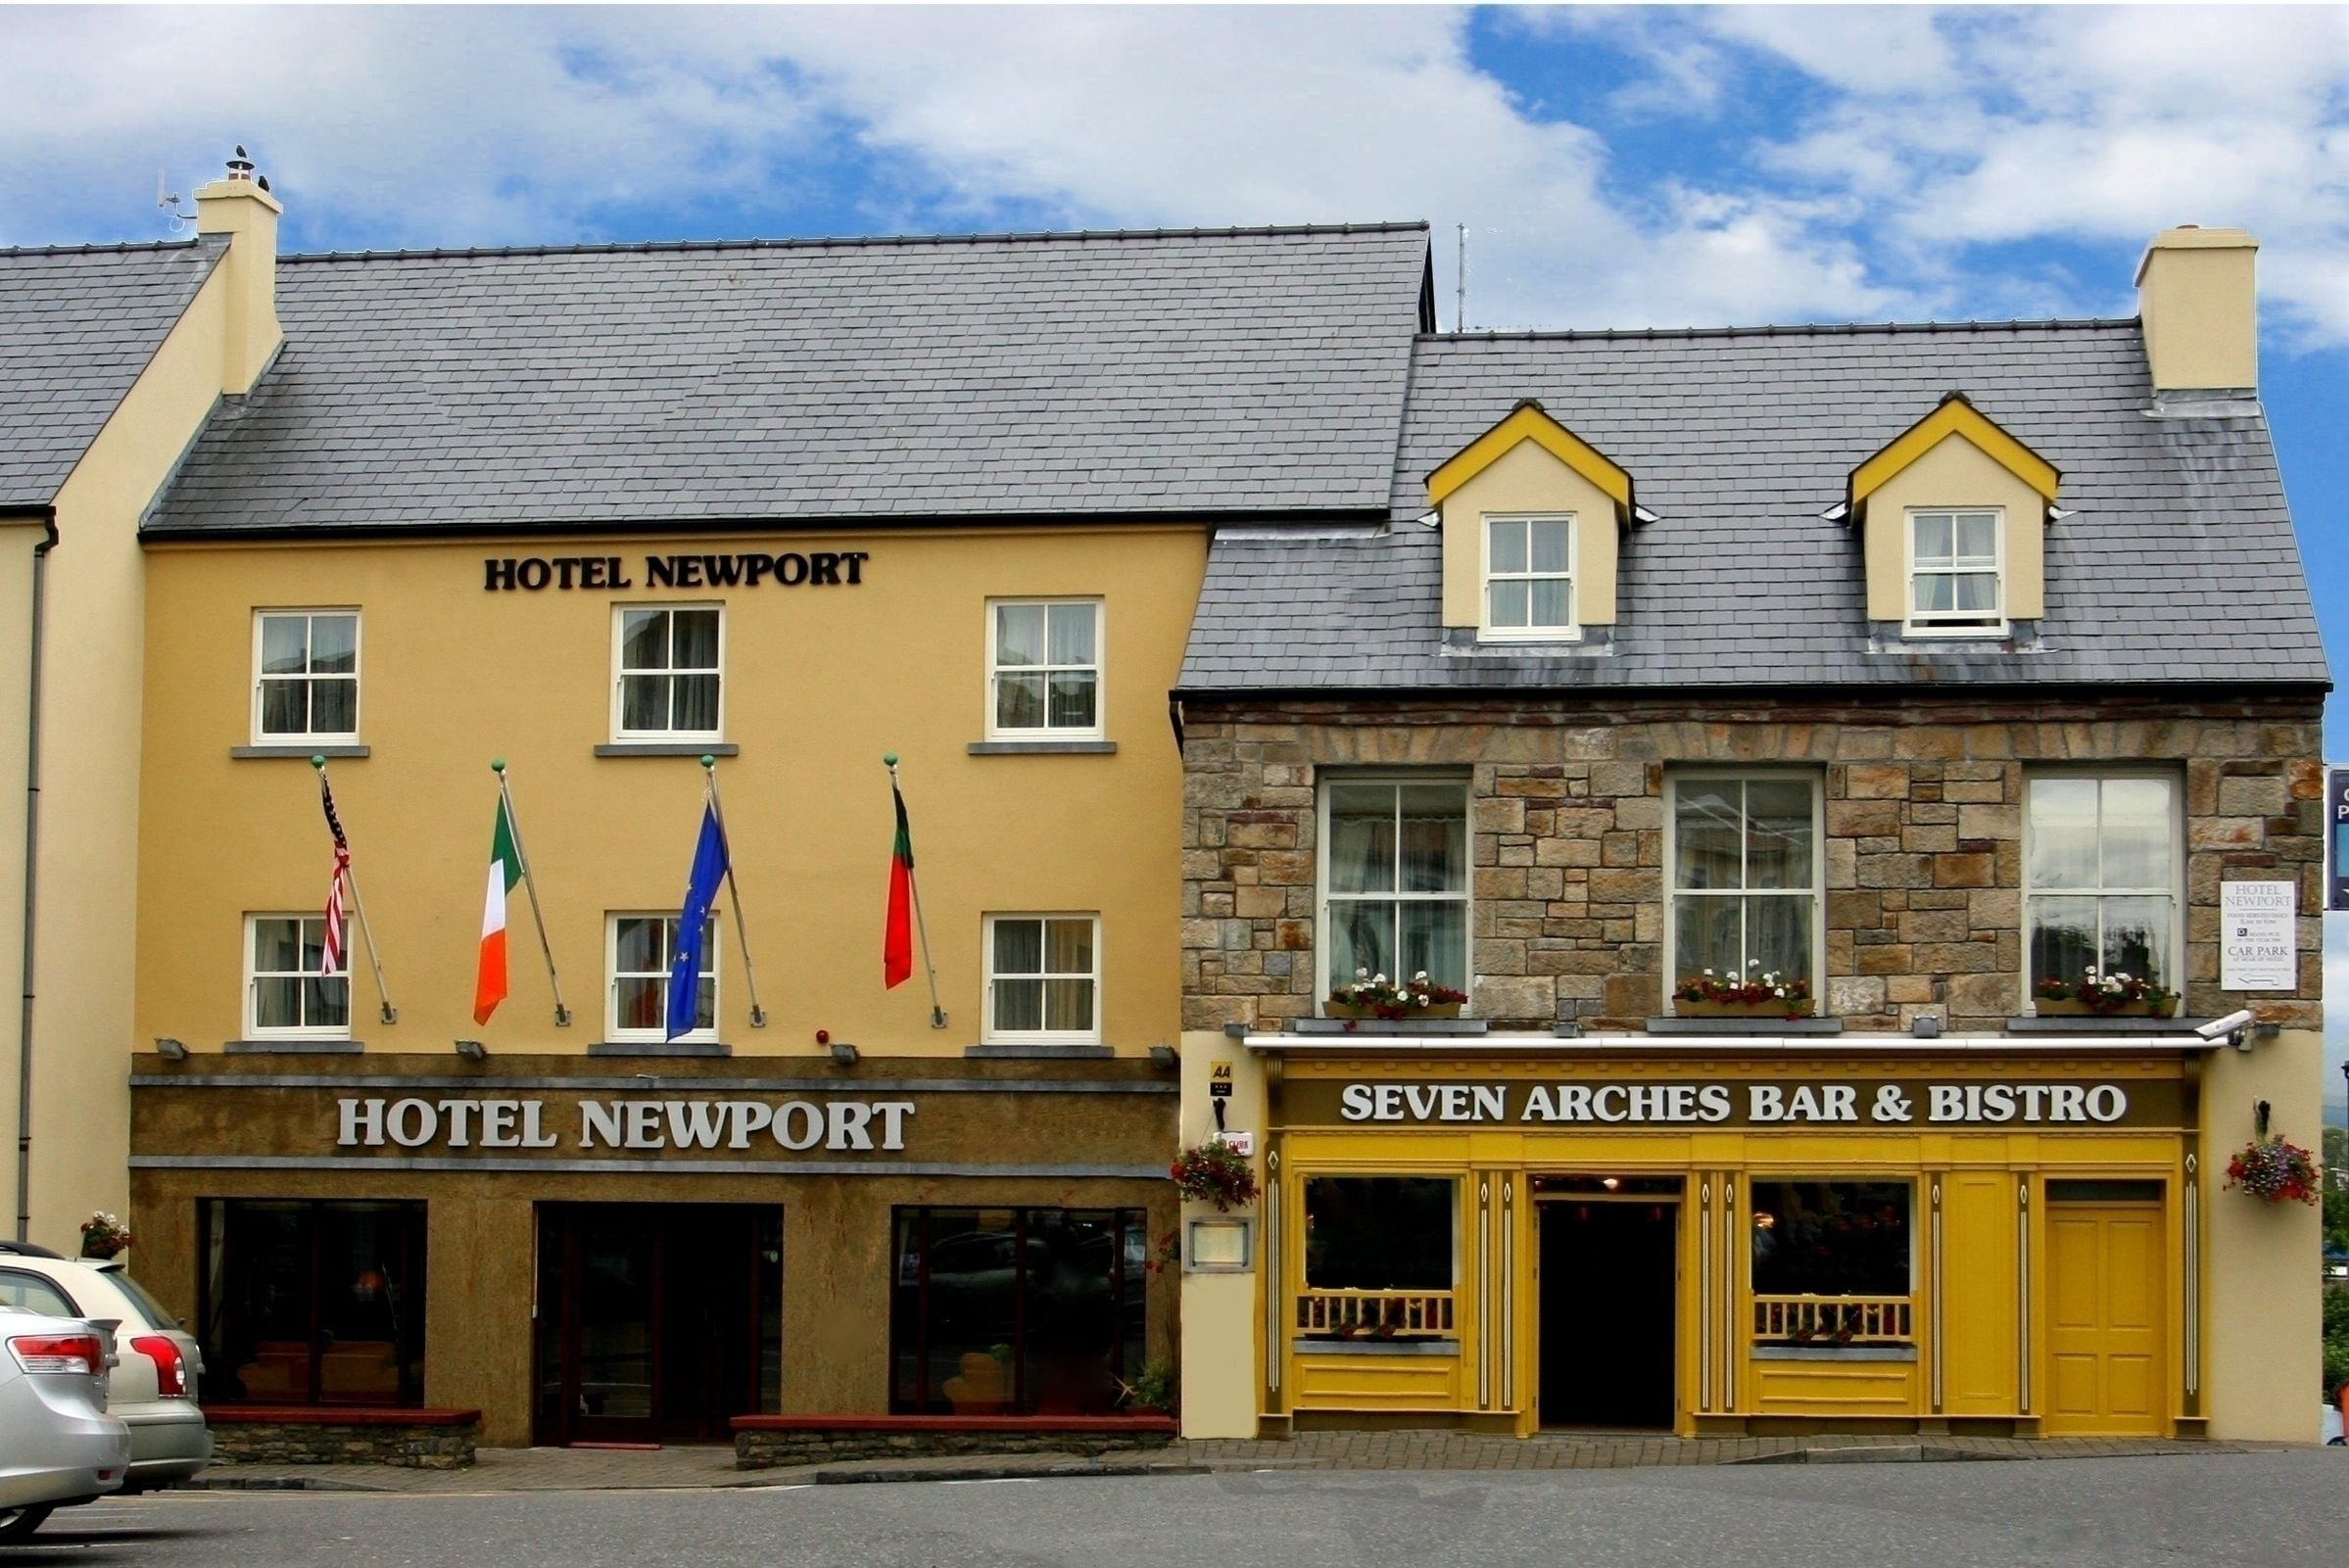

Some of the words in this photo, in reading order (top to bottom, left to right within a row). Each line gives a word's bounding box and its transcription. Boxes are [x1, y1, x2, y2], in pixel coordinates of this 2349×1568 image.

[484, 557, 632, 591] HOTEL
[646, 551, 869, 588] NEWPORT
[2235, 884, 2281, 895] HOTEL
[2225, 895, 2291, 907] NEWPORT
[2228, 946, 2254, 956] CAR
[2257, 946, 2288, 956] PARK
[1213, 1065, 1231, 1078] AA
[1340, 1083, 1507, 1121] SEVEN
[1520, 1084, 1731, 1122] ARCHES
[1748, 1085, 1859, 1121] BAR
[1871, 1084, 1913, 1122] &
[1928, 1084, 2128, 1122] BISTRO
[337, 1098, 558, 1148] HOTEL
[578, 1101, 916, 1151] NEWPORT
